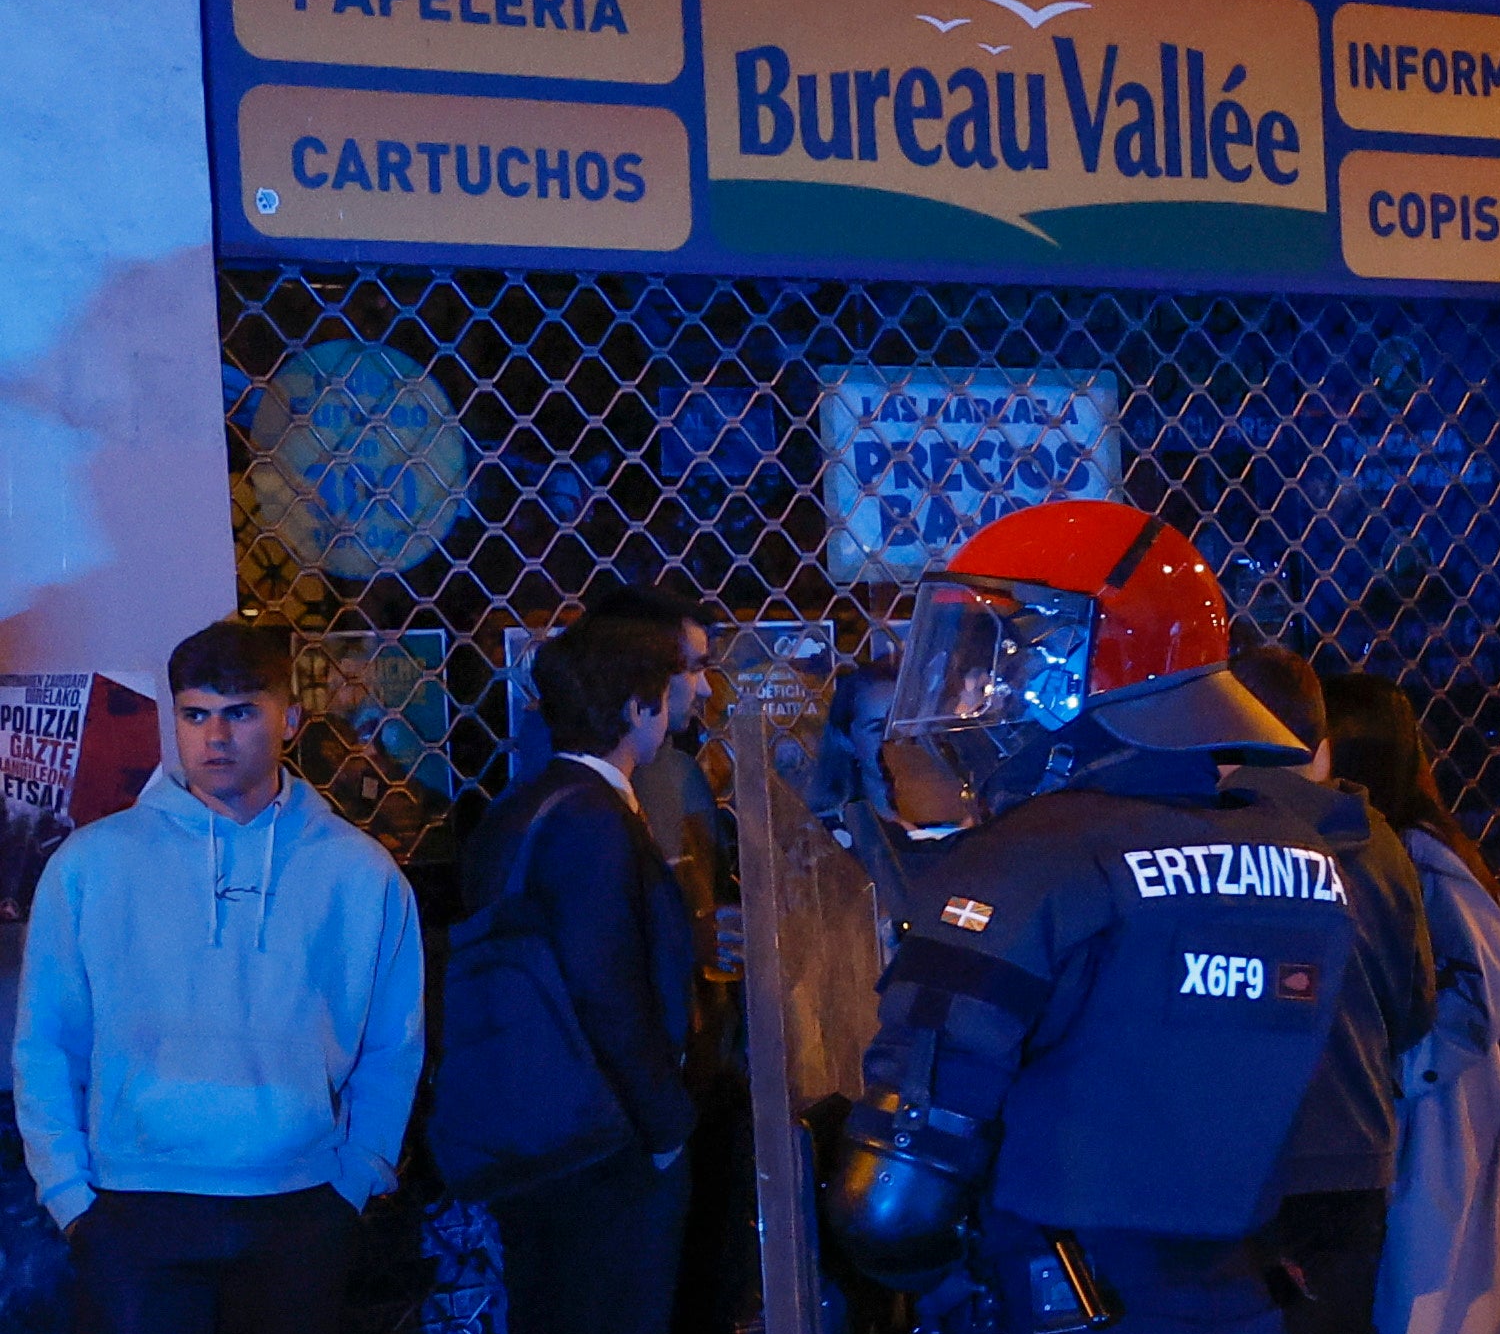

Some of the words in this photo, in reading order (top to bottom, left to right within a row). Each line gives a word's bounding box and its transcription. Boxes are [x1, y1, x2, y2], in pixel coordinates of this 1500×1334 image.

[735, 44, 1049, 172] Bureau
[1052, 36, 1300, 185] Vallée
[291, 136, 646, 203] CARTUCHOS
[0, 704, 80, 742] POLIZIA
[10, 732, 77, 771] GAZTE
[1124, 844, 1348, 906] ERTZAINTZA
[1179, 952, 1264, 1000] X6F9
